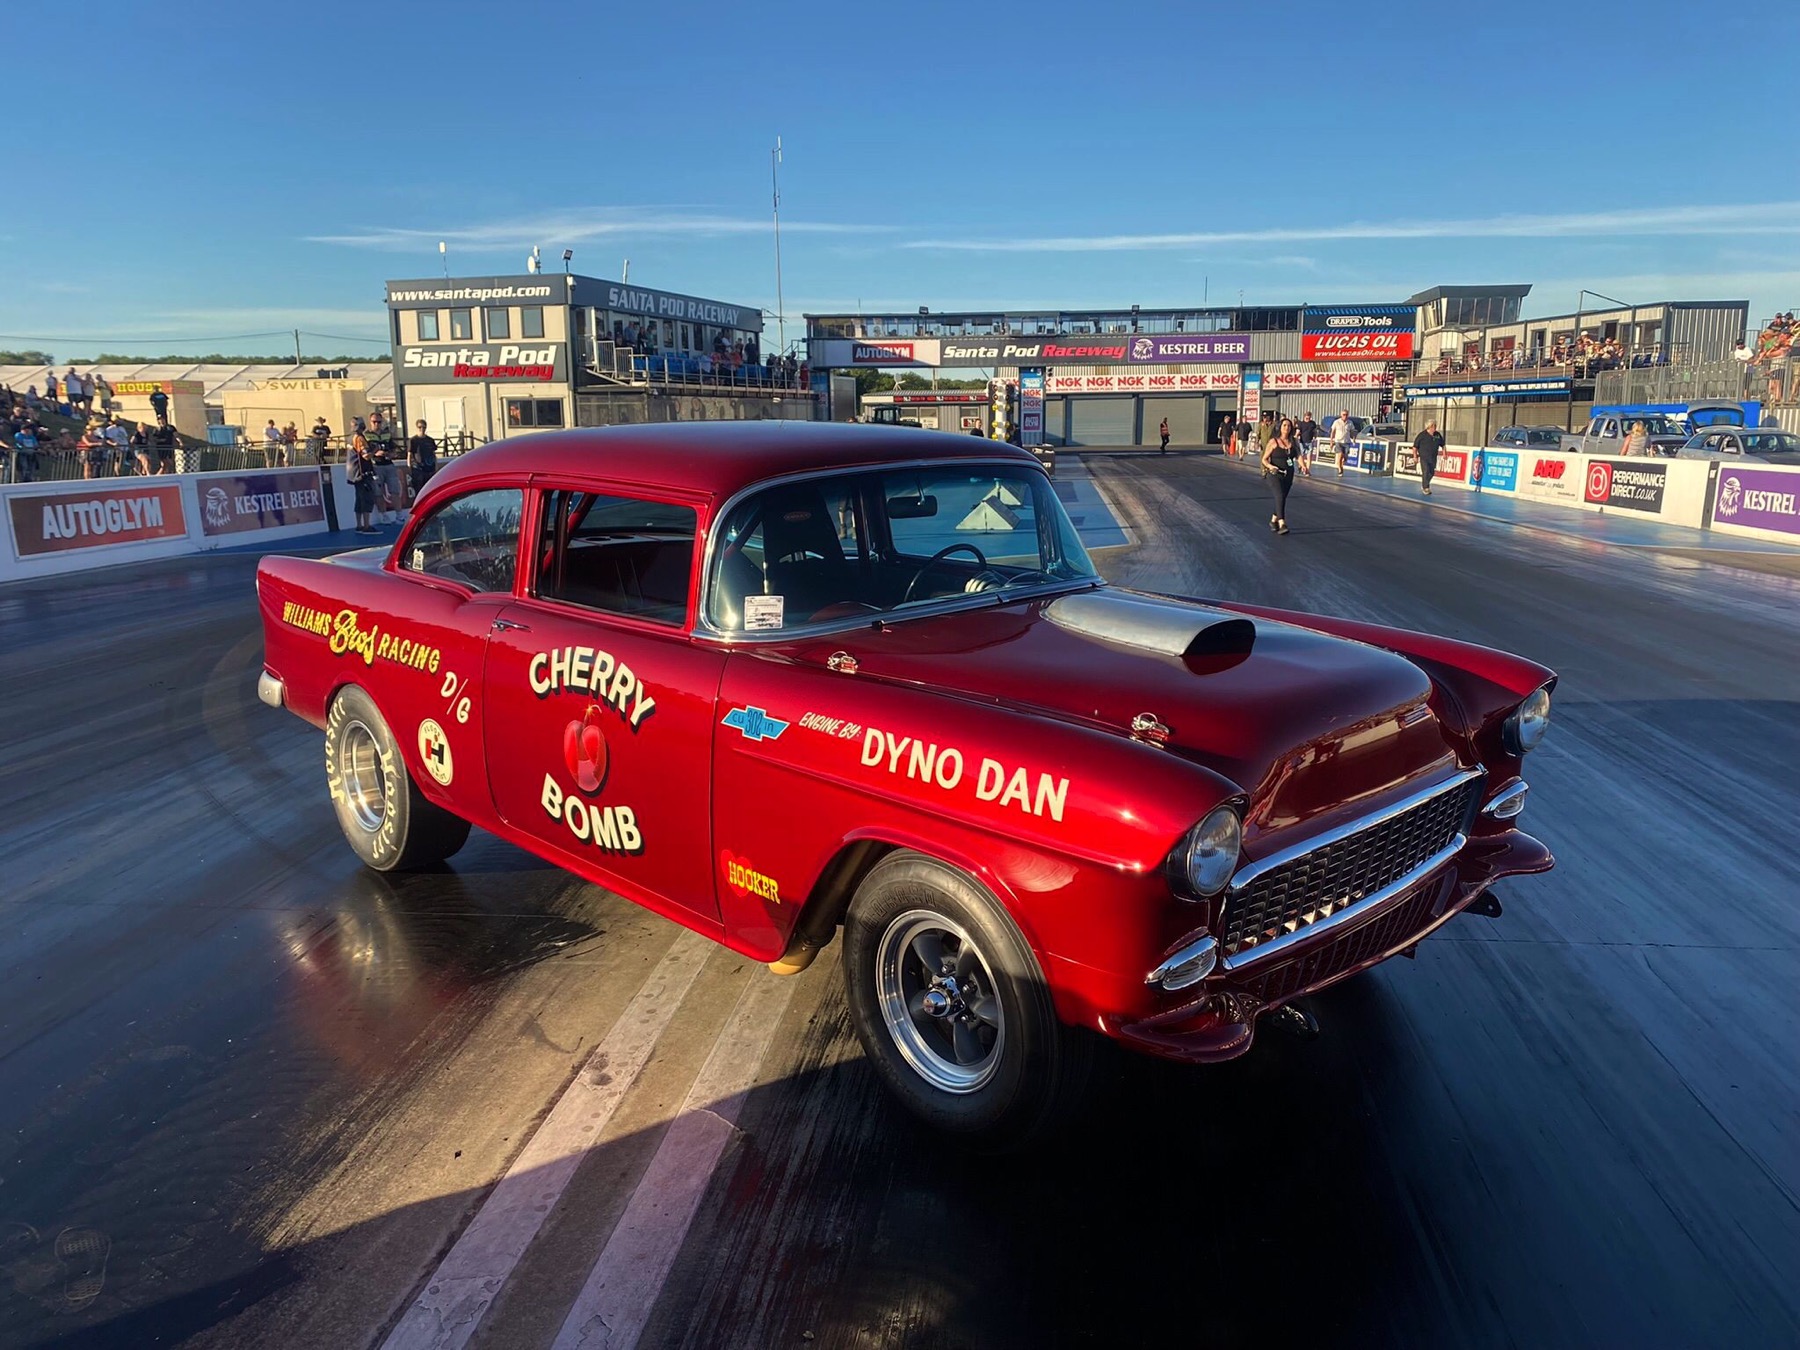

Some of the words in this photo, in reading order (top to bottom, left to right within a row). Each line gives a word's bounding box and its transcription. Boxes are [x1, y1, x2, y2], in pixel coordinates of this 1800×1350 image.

[391, 286, 550, 301] www.santapod.com
[608, 287, 655, 313] SANTA
[659, 297, 685, 317] POD
[687, 301, 740, 325] RACEWAY
[1363, 316, 1392, 326] Tools
[1159, 343, 1212, 355] KESTREL
[1214, 342, 1245, 354] BEER
[1315, 336, 1370, 349] LUCAS
[1372, 335, 1398, 348] OIL
[403, 347, 490, 367] Santa
[499, 345, 557, 366] Pod
[855, 347, 910, 359] AUTOGLYM
[943, 346, 998, 359] Santa
[1002, 345, 1040, 357] Pod
[1041, 345, 1126, 359] Raceway
[453, 363, 554, 380] Raceway
[1180, 375, 1207, 385] NGK
[1211, 374, 1239, 384] NGK
[1275, 374, 1302, 383] NGK
[1307, 373, 1334, 383] NGK
[1339, 373, 1367, 383] NGK
[1056, 378, 1082, 387] NGK
[1087, 377, 1113, 386] NGK
[1117, 376, 1144, 386] NGK
[1149, 376, 1176, 385] NGK
[1533, 459, 1565, 479] ARP
[1612, 470, 1665, 487] PERFORMANCE
[235, 492, 288, 515] KESTREL
[290, 489, 319, 508] BEER
[1743, 489, 1796, 515] KESTREL
[43, 496, 163, 539] AUTOGLYM
[283, 601, 332, 636] WILLIAMS
[329, 609, 378, 665] Bros
[377, 633, 440, 674] RACING
[529, 646, 656, 729] CHERRY
[441, 671, 471, 724] D/G
[732, 713, 745, 724] cu
[745, 710, 763, 736] 302
[764, 721, 774, 733] in
[799, 711, 840, 736] ENGINE
[861, 728, 963, 789] DYNO
[975, 757, 1070, 822] DAN
[541, 772, 642, 852] BOMB
[728, 859, 780, 905] HOOKER
